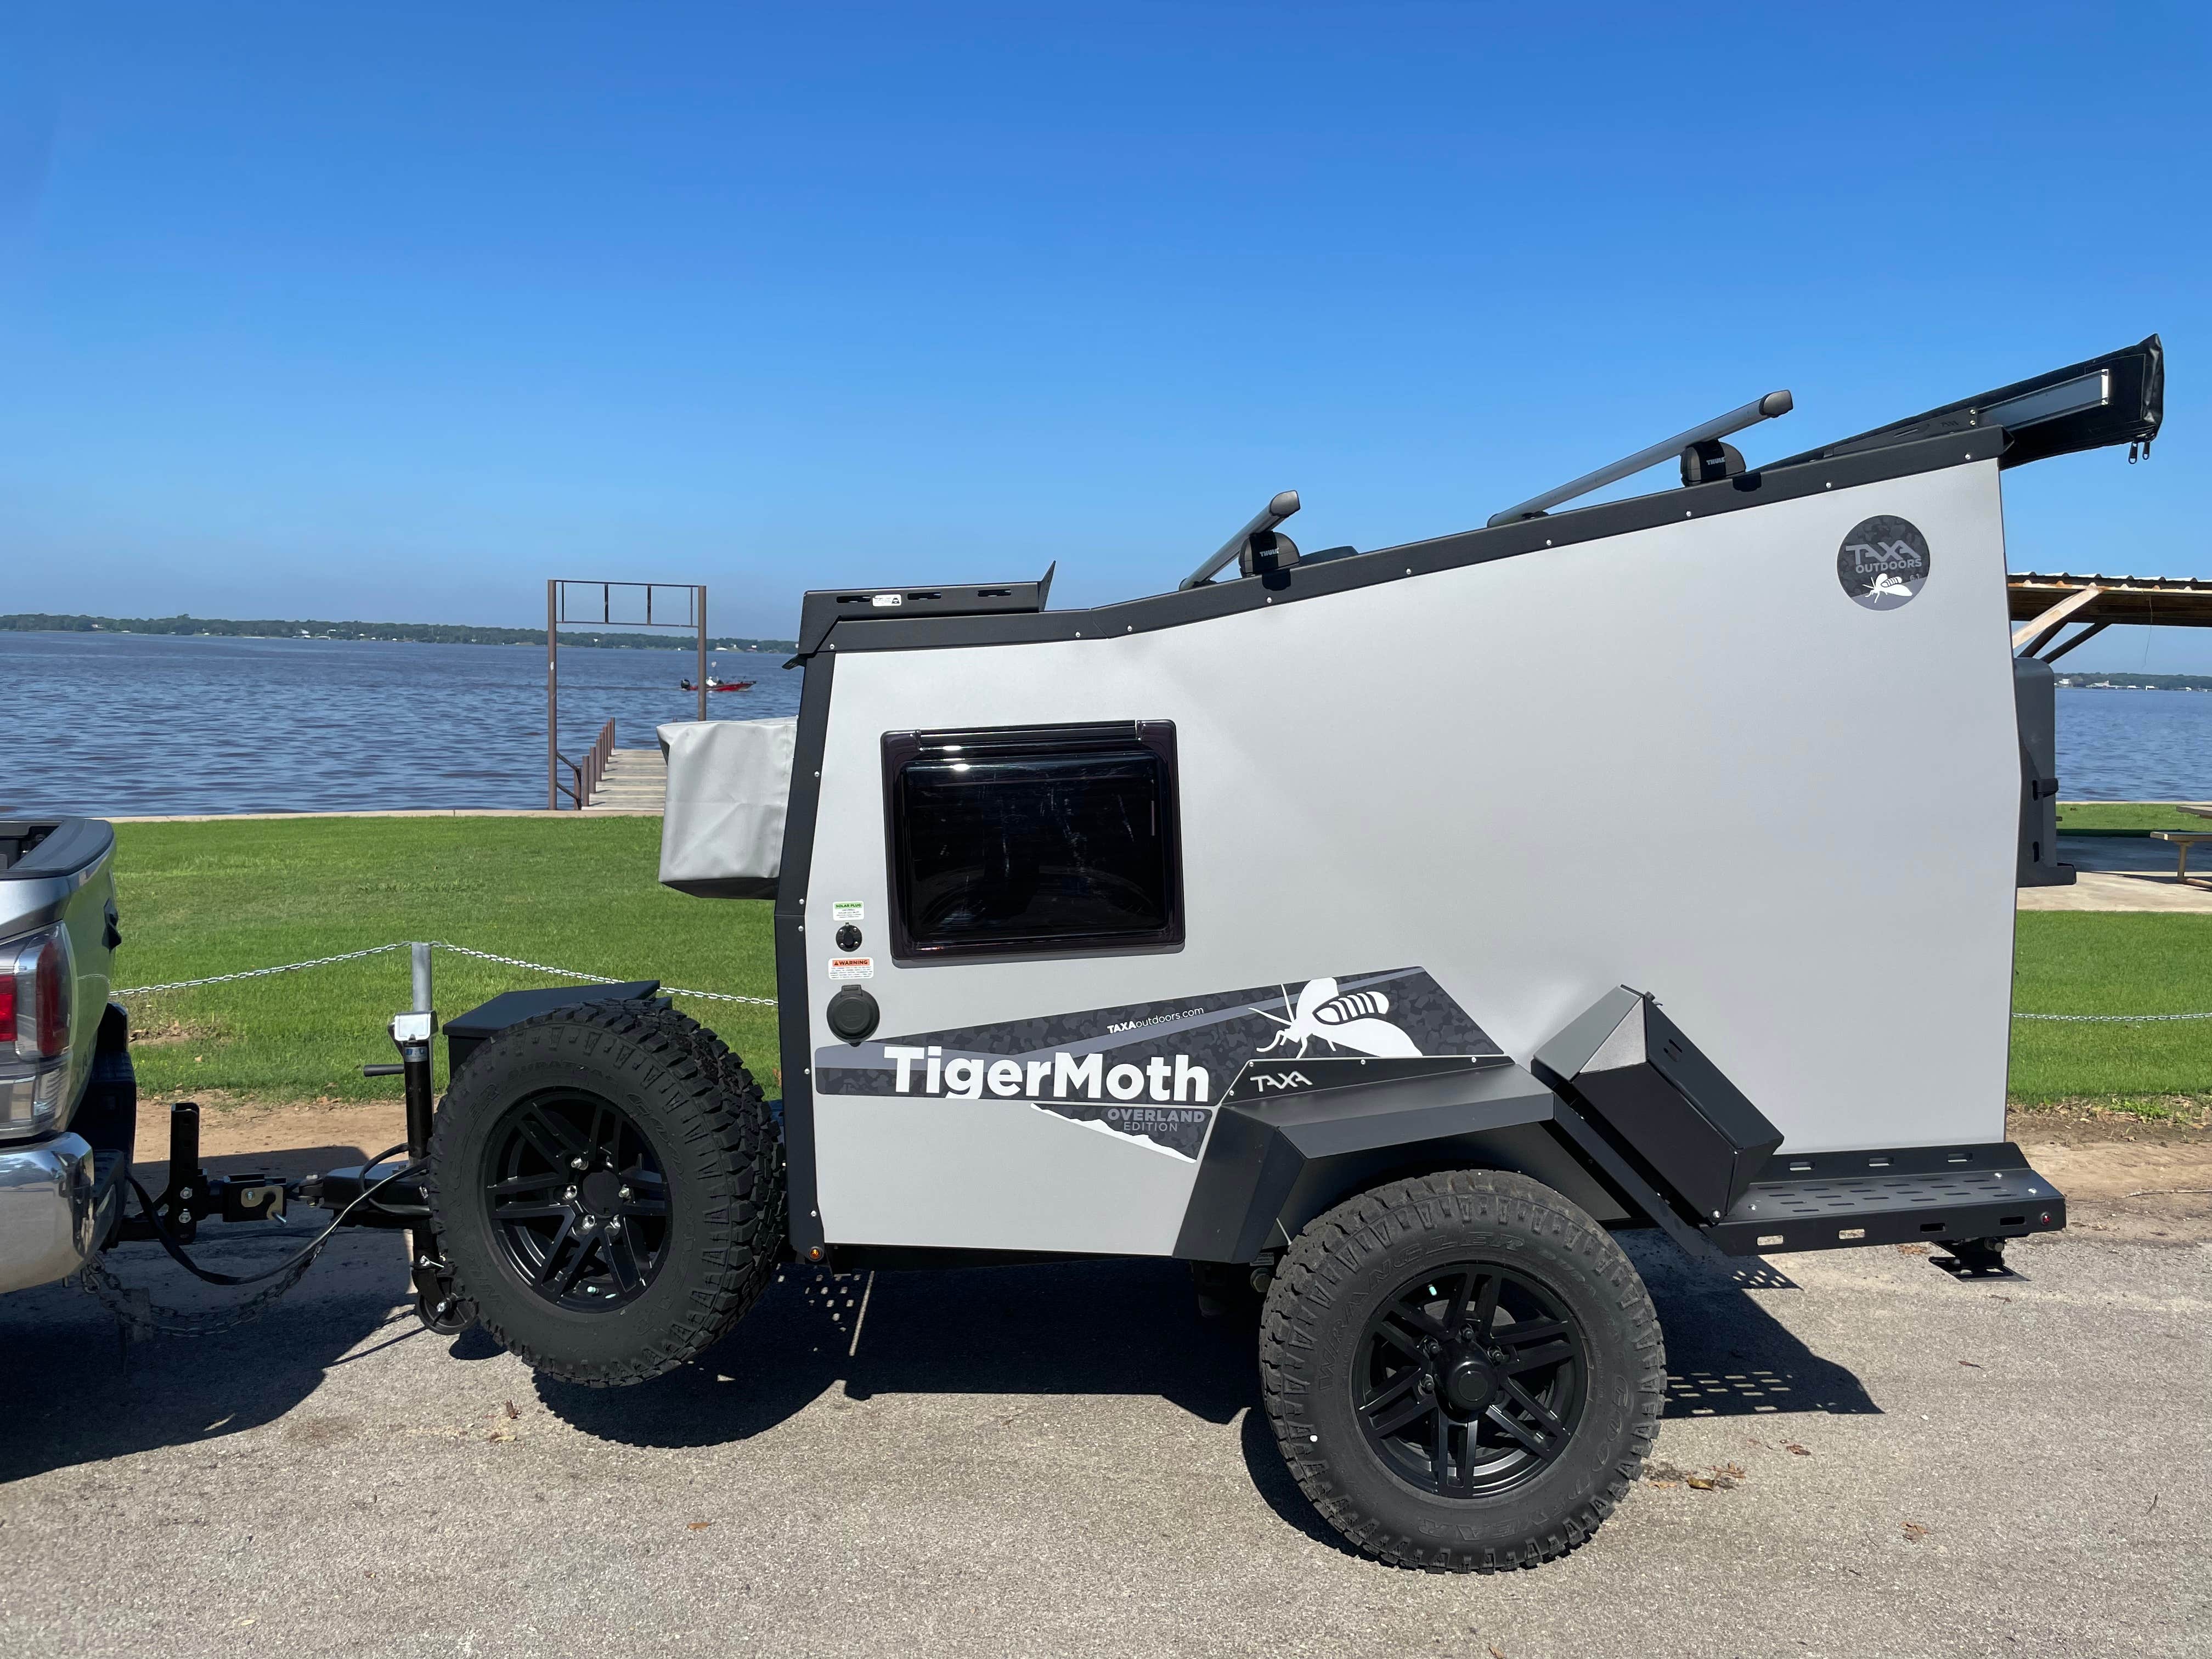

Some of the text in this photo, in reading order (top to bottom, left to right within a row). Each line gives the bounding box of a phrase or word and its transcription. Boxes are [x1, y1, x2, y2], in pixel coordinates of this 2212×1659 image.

[1846, 539, 1921, 565] TAXA
[1855, 558, 1922, 574] OUTDOORS
[1107, 1007, 1204, 1034] TAXAoutdoors.com
[884, 1046, 1209, 1102] TigerMoth
[1250, 1070, 1313, 1092] TAXA
[1107, 1108, 1205, 1123] OVERLAND
[1124, 1121, 1178, 1132] EDITION
